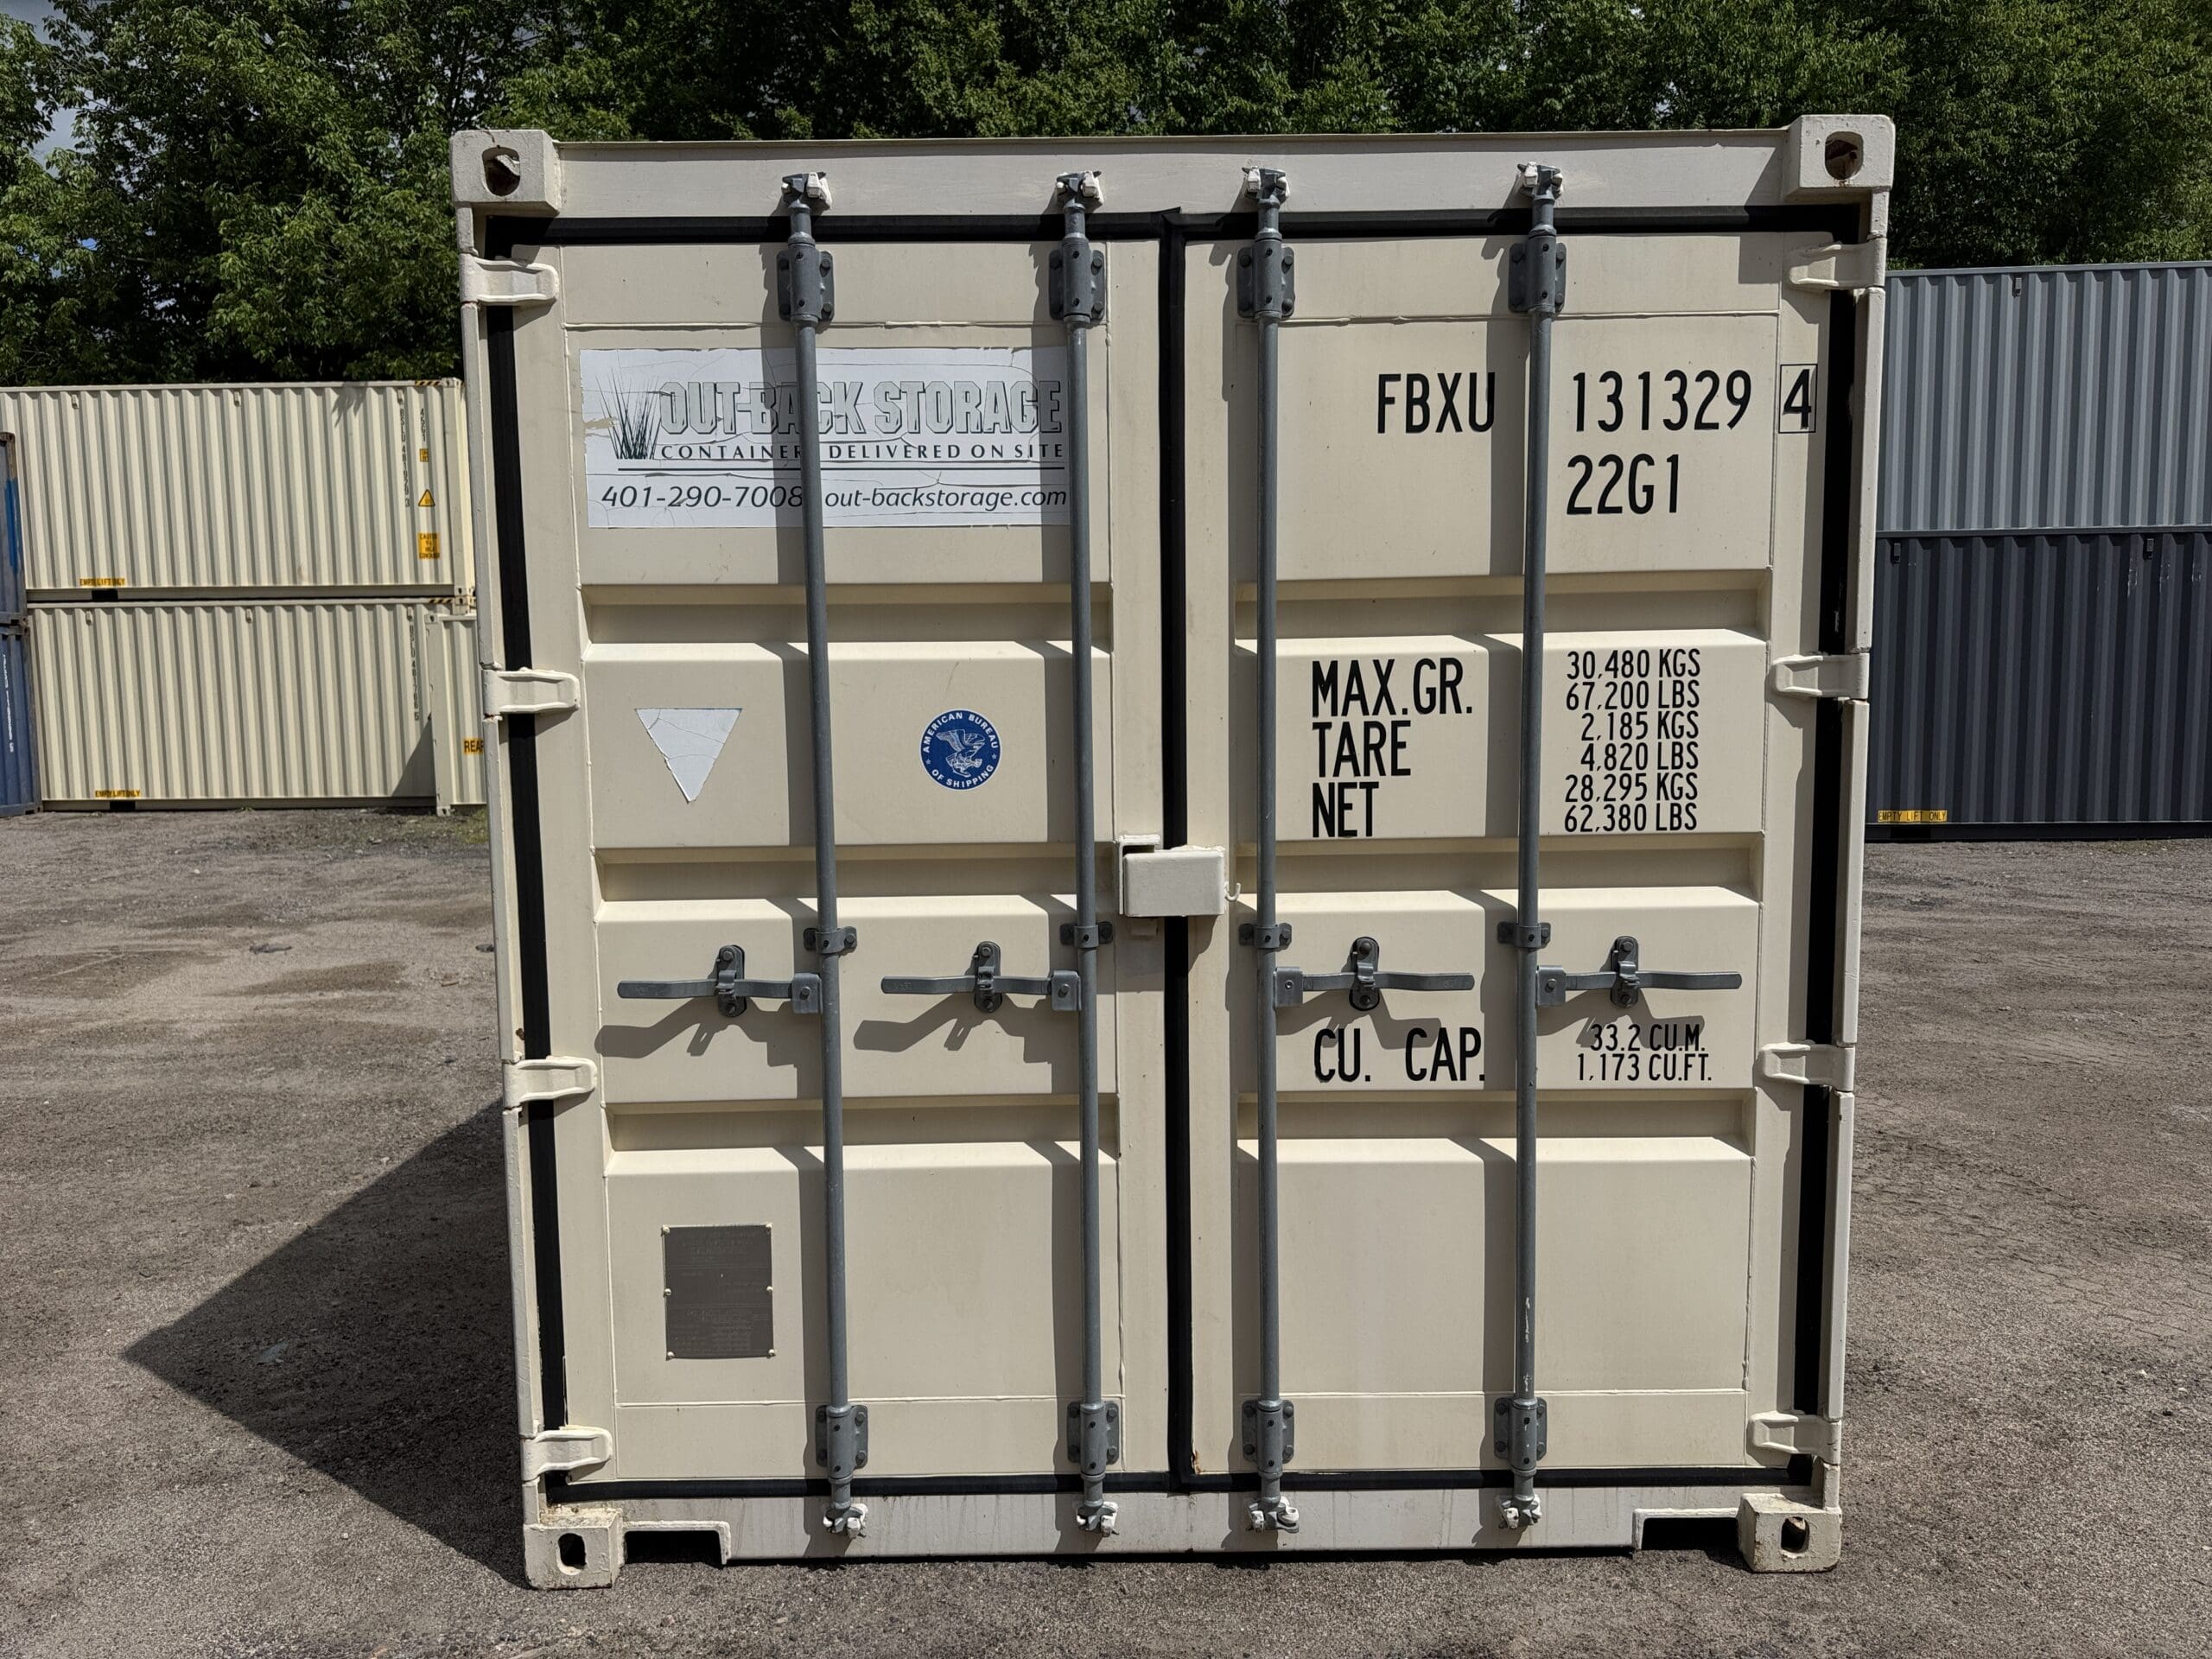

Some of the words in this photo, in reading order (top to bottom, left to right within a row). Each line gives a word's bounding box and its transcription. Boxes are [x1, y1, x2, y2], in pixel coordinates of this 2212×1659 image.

[873, 380, 1063, 434] STORAGE
[1376, 372, 1496, 434] FBXU
[1572, 369, 1752, 432] 131329
[1781, 367, 1814, 431] 4
[660, 443, 803, 460] CONTAINER
[829, 442, 961, 460] DELIVERED
[970, 443, 1003, 459] ON
[1014, 442, 1064, 459] SITE
[601, 484, 804, 508] 401-290-7008
[824, 485, 1067, 512] out-backstorage.com
[1566, 453, 1680, 516] 22G1
[1566, 649, 1650, 680] 30,480
[1658, 648, 1701, 677] KGS
[1311, 657, 1473, 718] MAX.GR.
[1565, 681, 1649, 711] 67,200
[1657, 679, 1700, 709] LBS
[922, 712, 963, 753] AMERICAN
[968, 714, 999, 749] BUREAU
[1580, 711, 1649, 742] 2,185
[1656, 710, 1700, 741] KGS
[1312, 720, 1412, 778] TARE
[1580, 741, 1649, 772] 4,820
[1656, 741, 1700, 771] LBS
[931, 769, 944, 781] OF
[945, 764, 995, 788] SHIPPING
[1564, 772, 1649, 804] 28,295
[1656, 772, 1700, 802] KGS
[1312, 781, 1380, 838] NET
[1563, 803, 1648, 834] 62,380
[1655, 802, 1698, 831] LBS
[1878, 810, 1901, 821] EMPTY
[1906, 810, 1923, 821] LIFT
[1929, 810, 1947, 821] ONLY
[1589, 1023, 1642, 1052] 33.2
[1649, 1023, 1706, 1052] CU.M.
[1313, 1027, 1371, 1083] CU.
[1404, 1027, 1486, 1082] CAP.
[1577, 1052, 1642, 1083] 1,173
[1648, 1052, 1713, 1082] CU.FT.
